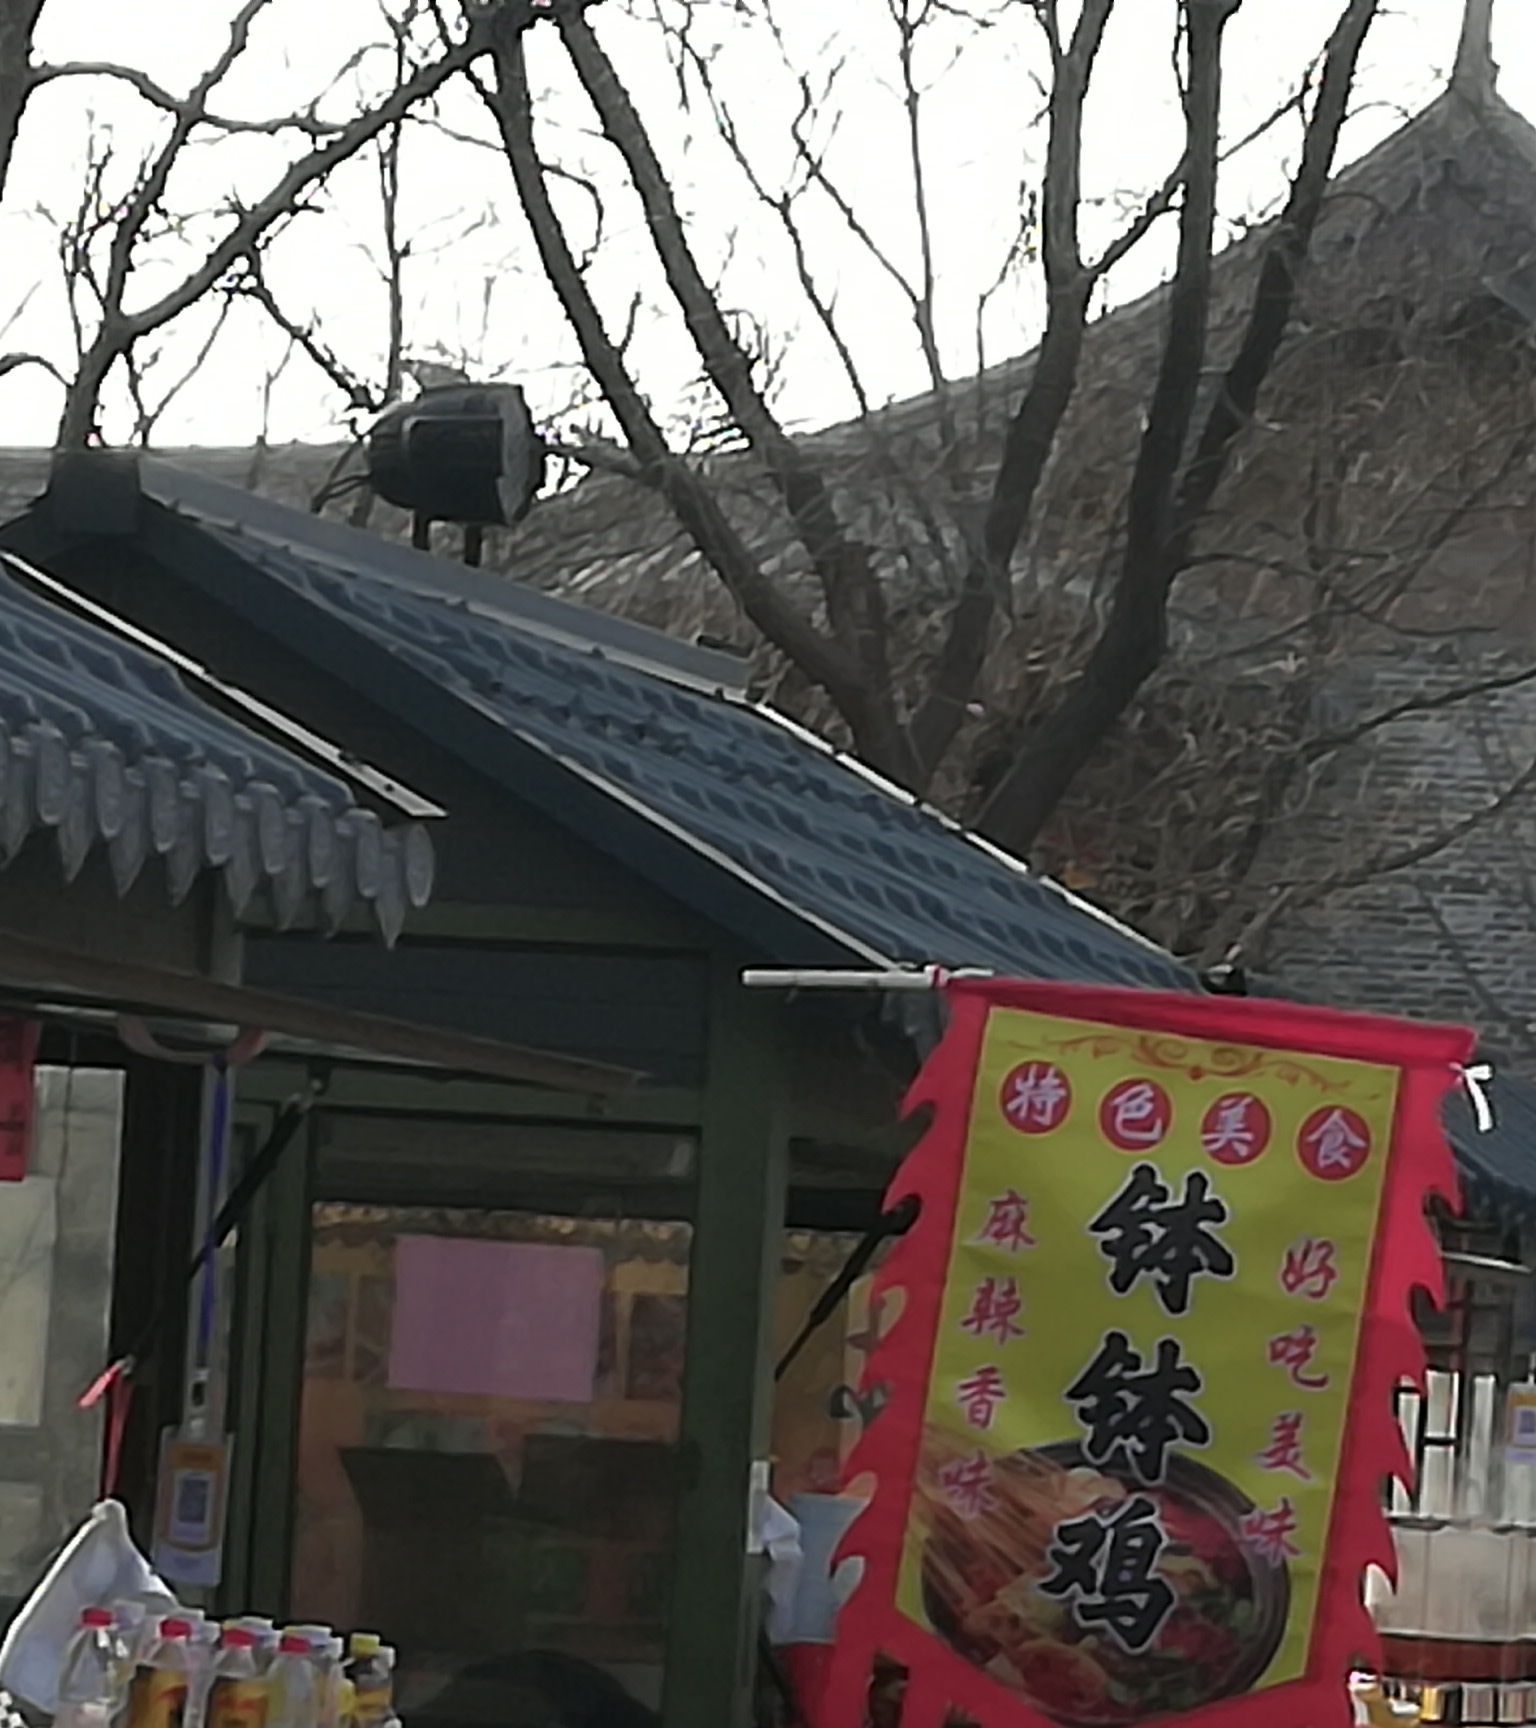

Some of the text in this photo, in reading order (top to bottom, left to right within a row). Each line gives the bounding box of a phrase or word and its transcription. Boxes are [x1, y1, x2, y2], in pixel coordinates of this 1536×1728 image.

[1004, 1070, 1368, 1169] 特色美食
[938, 1188, 1038, 1520] 麻辣香味
[1034, 1163, 1236, 1652] 钵钵鸡
[1239, 1236, 1340, 1566] 好吃美味
